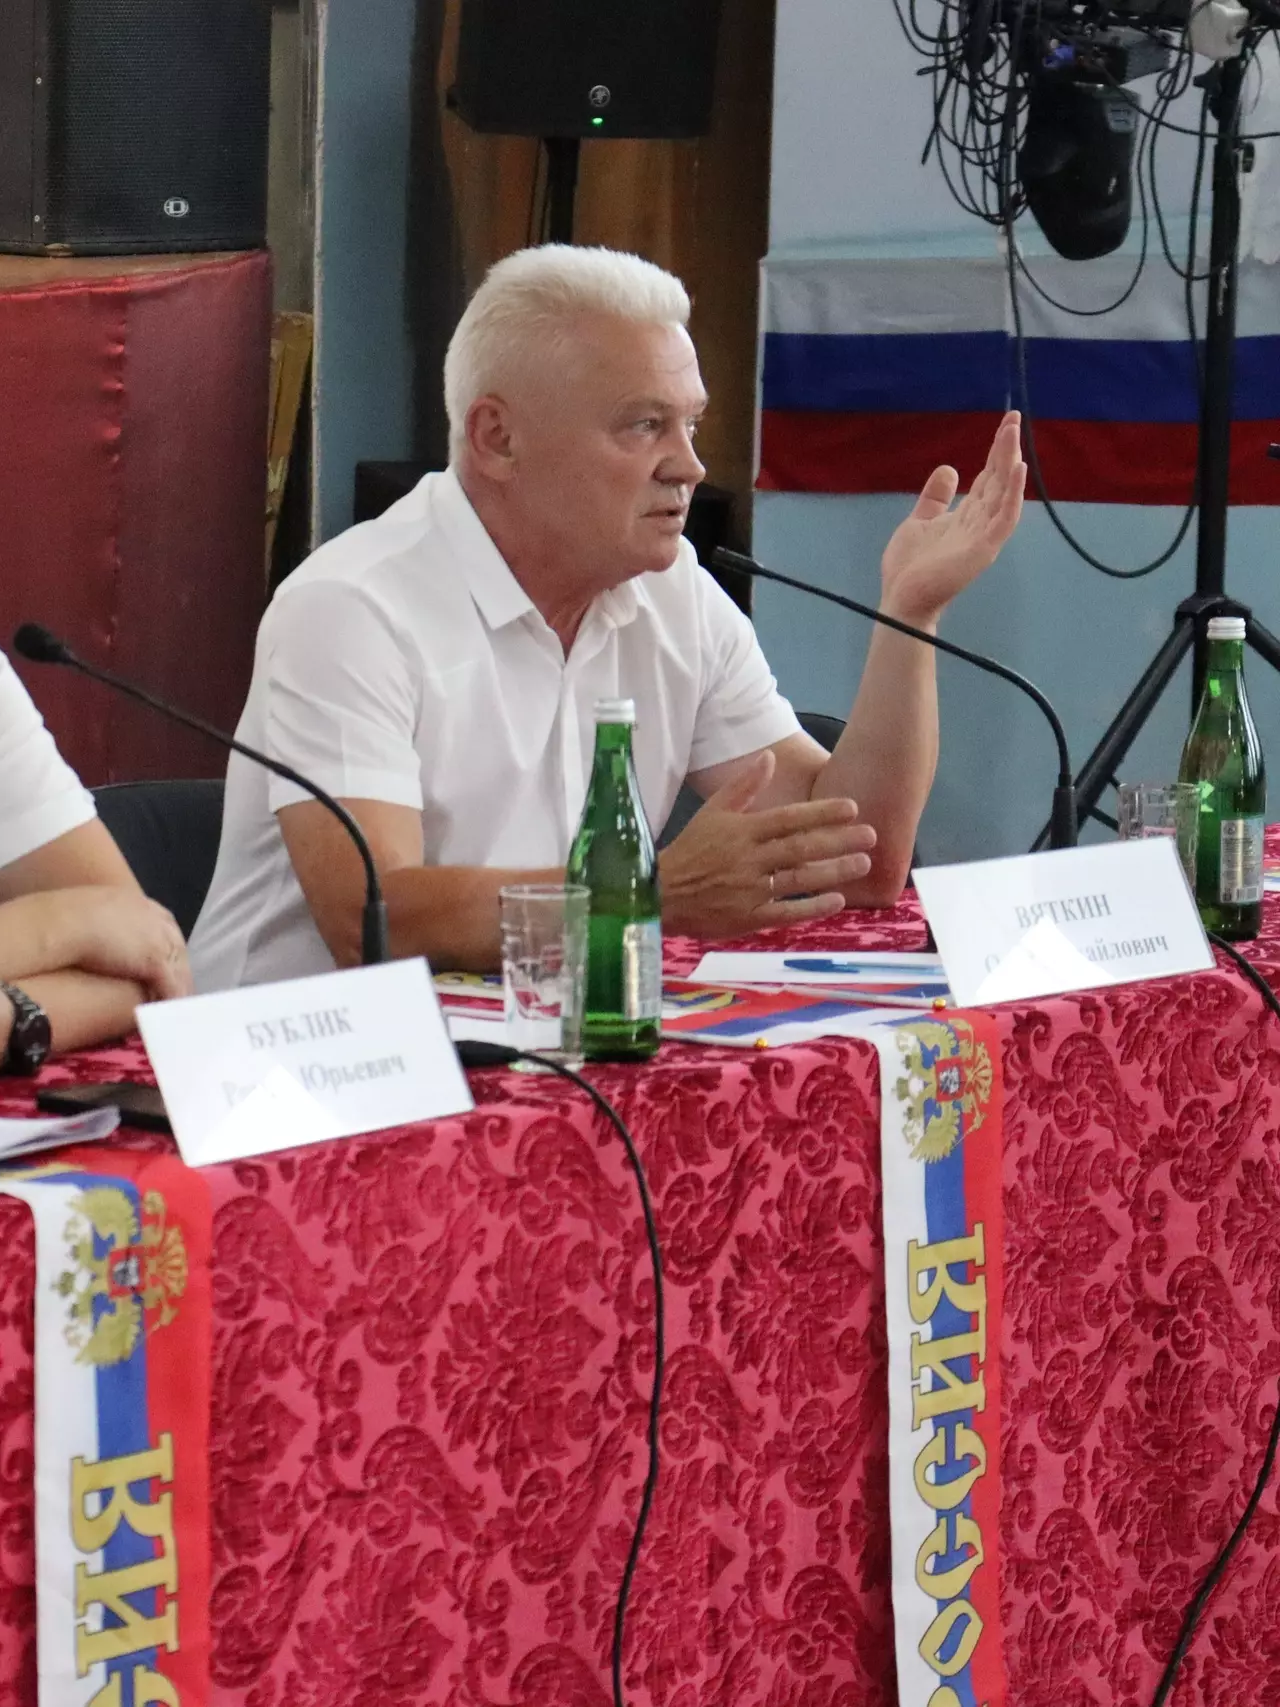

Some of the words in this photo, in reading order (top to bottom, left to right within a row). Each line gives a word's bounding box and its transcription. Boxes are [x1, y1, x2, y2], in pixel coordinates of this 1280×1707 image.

[1014, 893, 1112, 928] ВЯТКИН
[1084, 935, 1169, 963] айлович
[245, 1004, 355, 1050] БУБЛИК
[298, 1053, 407, 1094] Юрьевич
[907, 1221, 988, 1707] ОССИЯ
